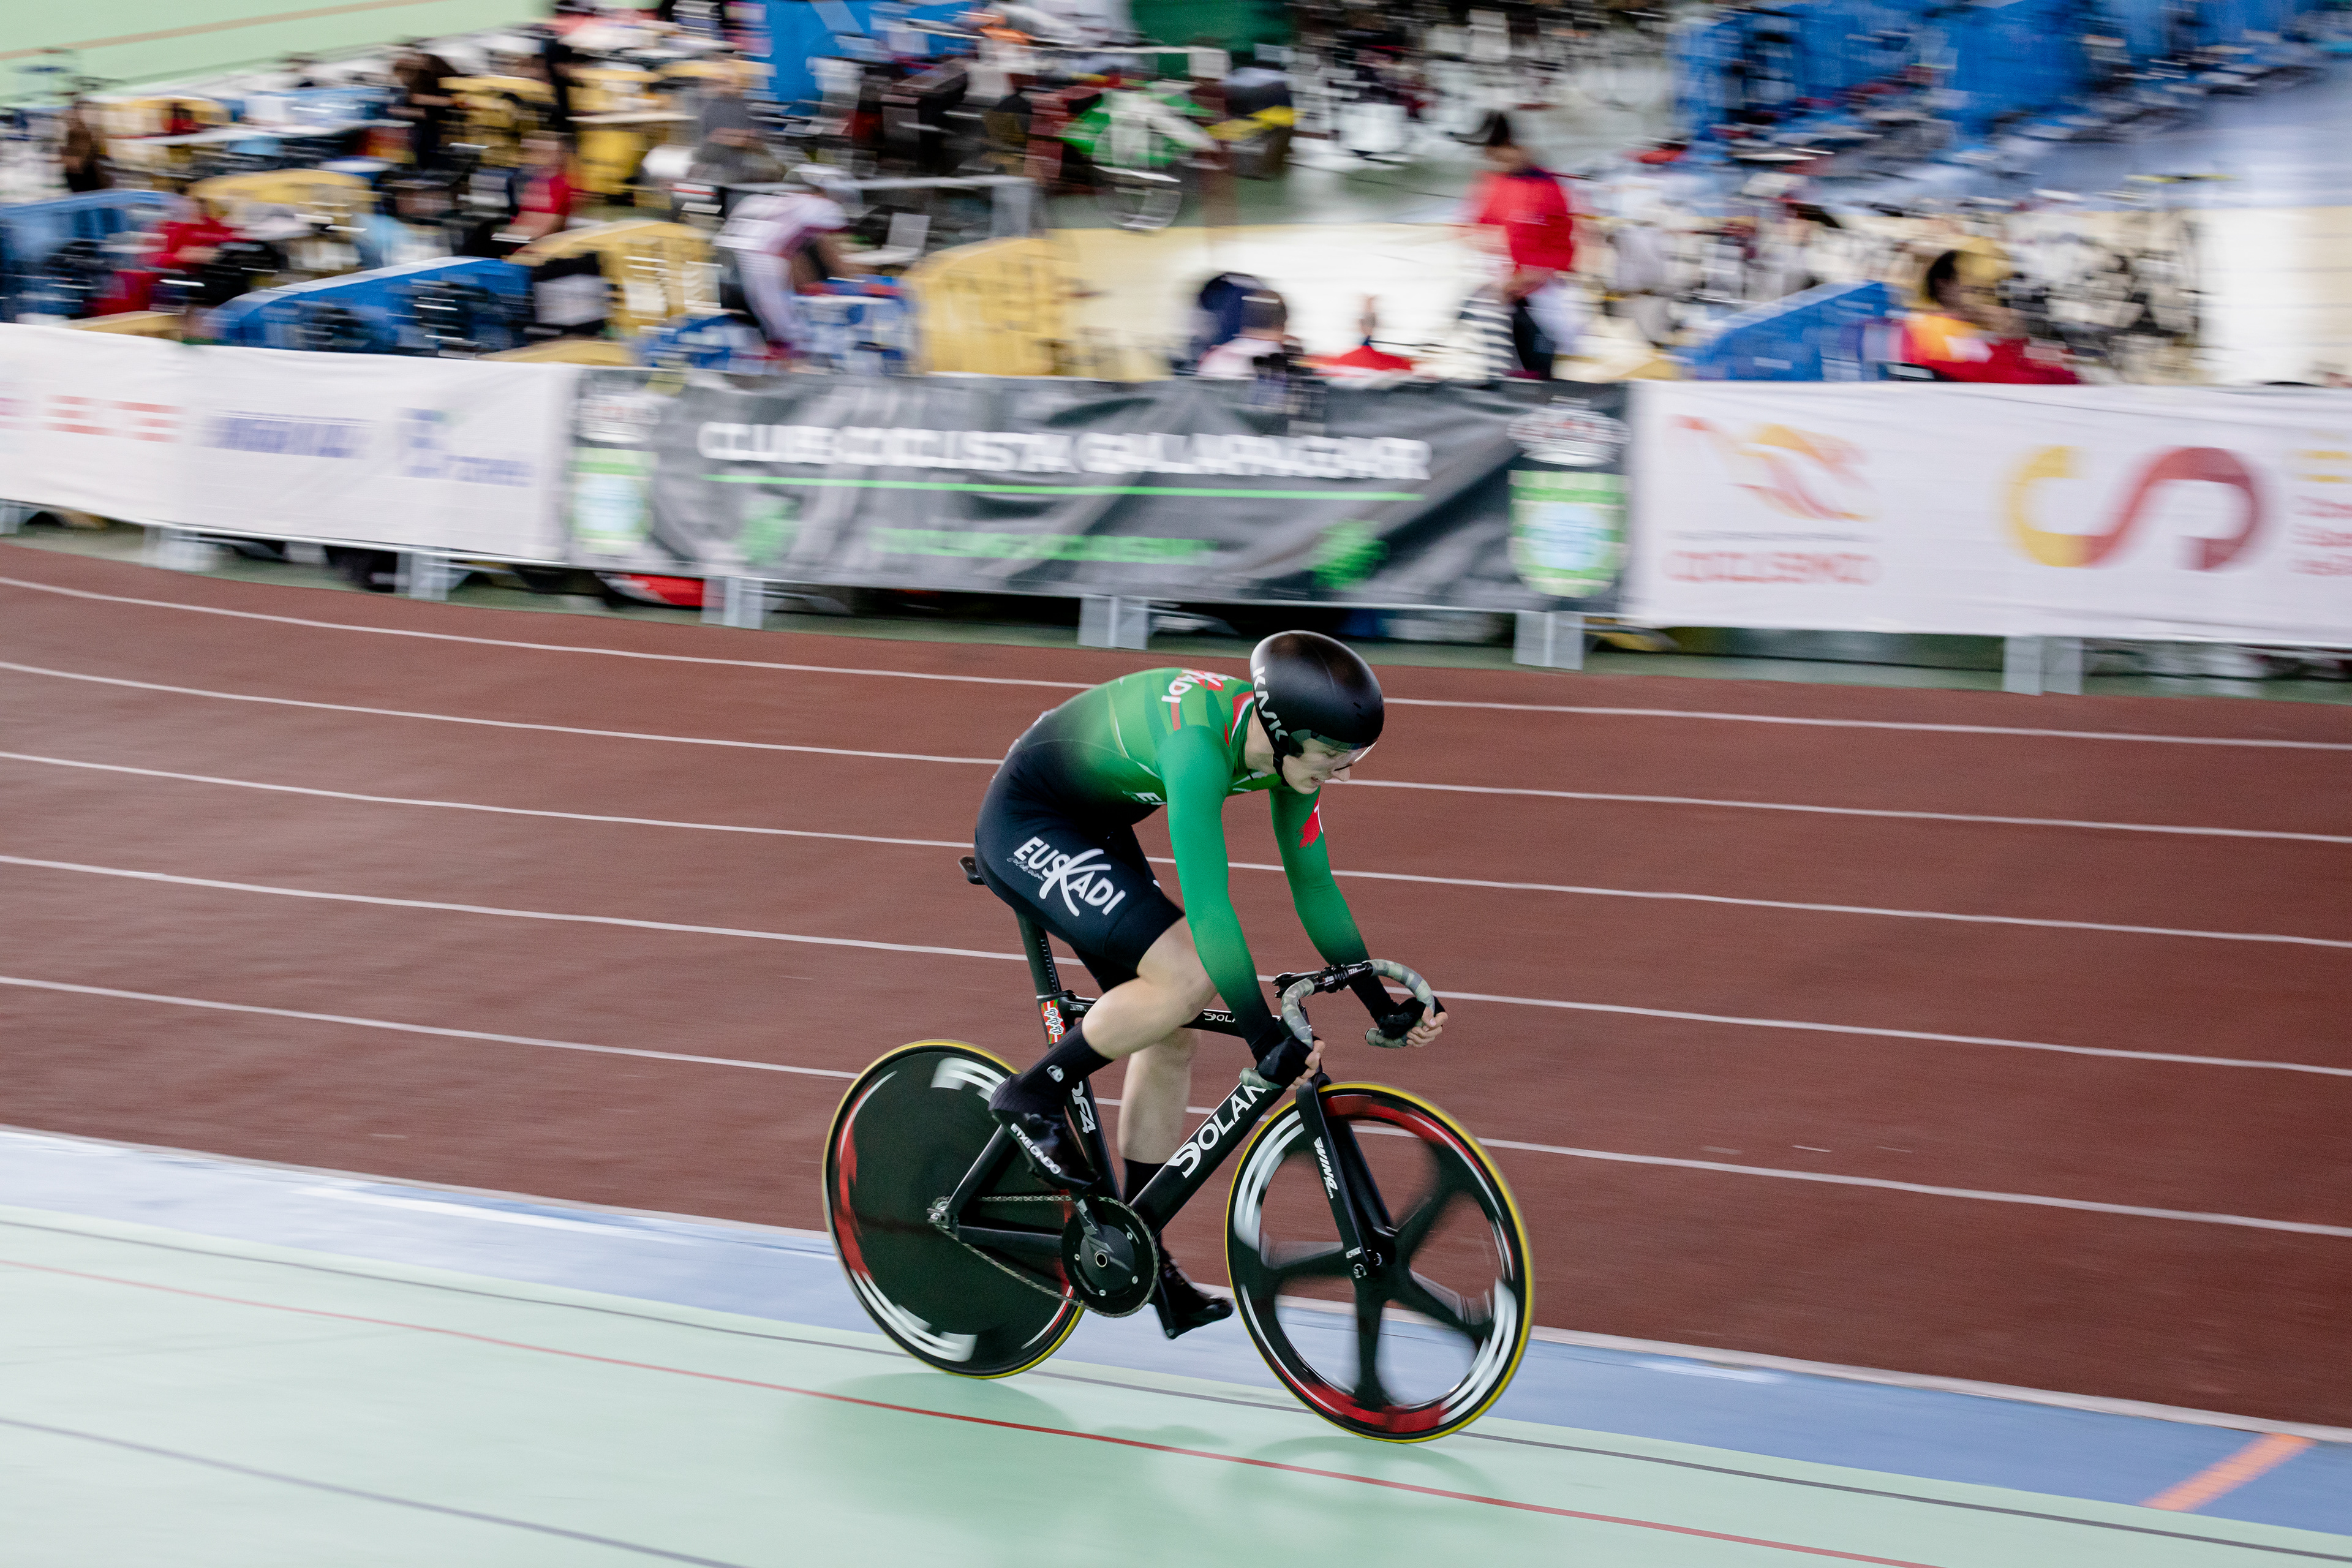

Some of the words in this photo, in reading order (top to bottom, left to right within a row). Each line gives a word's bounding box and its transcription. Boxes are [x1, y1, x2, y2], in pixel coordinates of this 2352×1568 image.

[696, 421, 835, 464] CLUB
[835, 425, 1073, 474] CICLISTA
[1253, 666, 1289, 742] KASK
[1014, 836, 1126, 918] EUSKADI
[1011, 1123, 1061, 1175] ETXEONDO
[1314, 1138, 1338, 1190] WING
